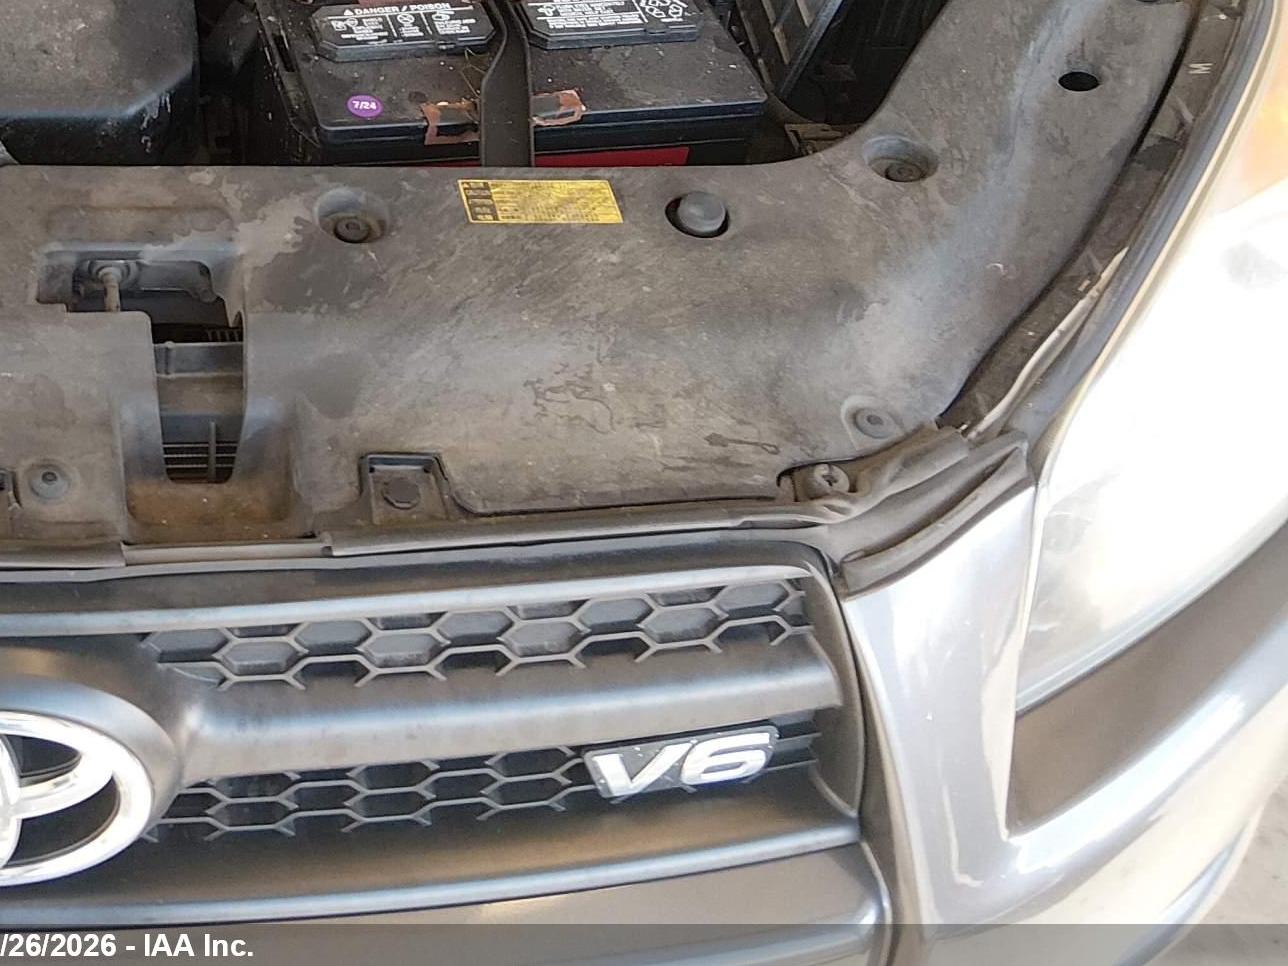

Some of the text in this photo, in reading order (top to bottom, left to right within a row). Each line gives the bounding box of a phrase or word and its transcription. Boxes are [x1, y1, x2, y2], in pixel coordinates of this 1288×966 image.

[353, 6, 400, 16] DANGER
[408, 2, 452, 12] POISON
[352, 100, 377, 110] 7/24
[591, 732, 771, 797] V6
